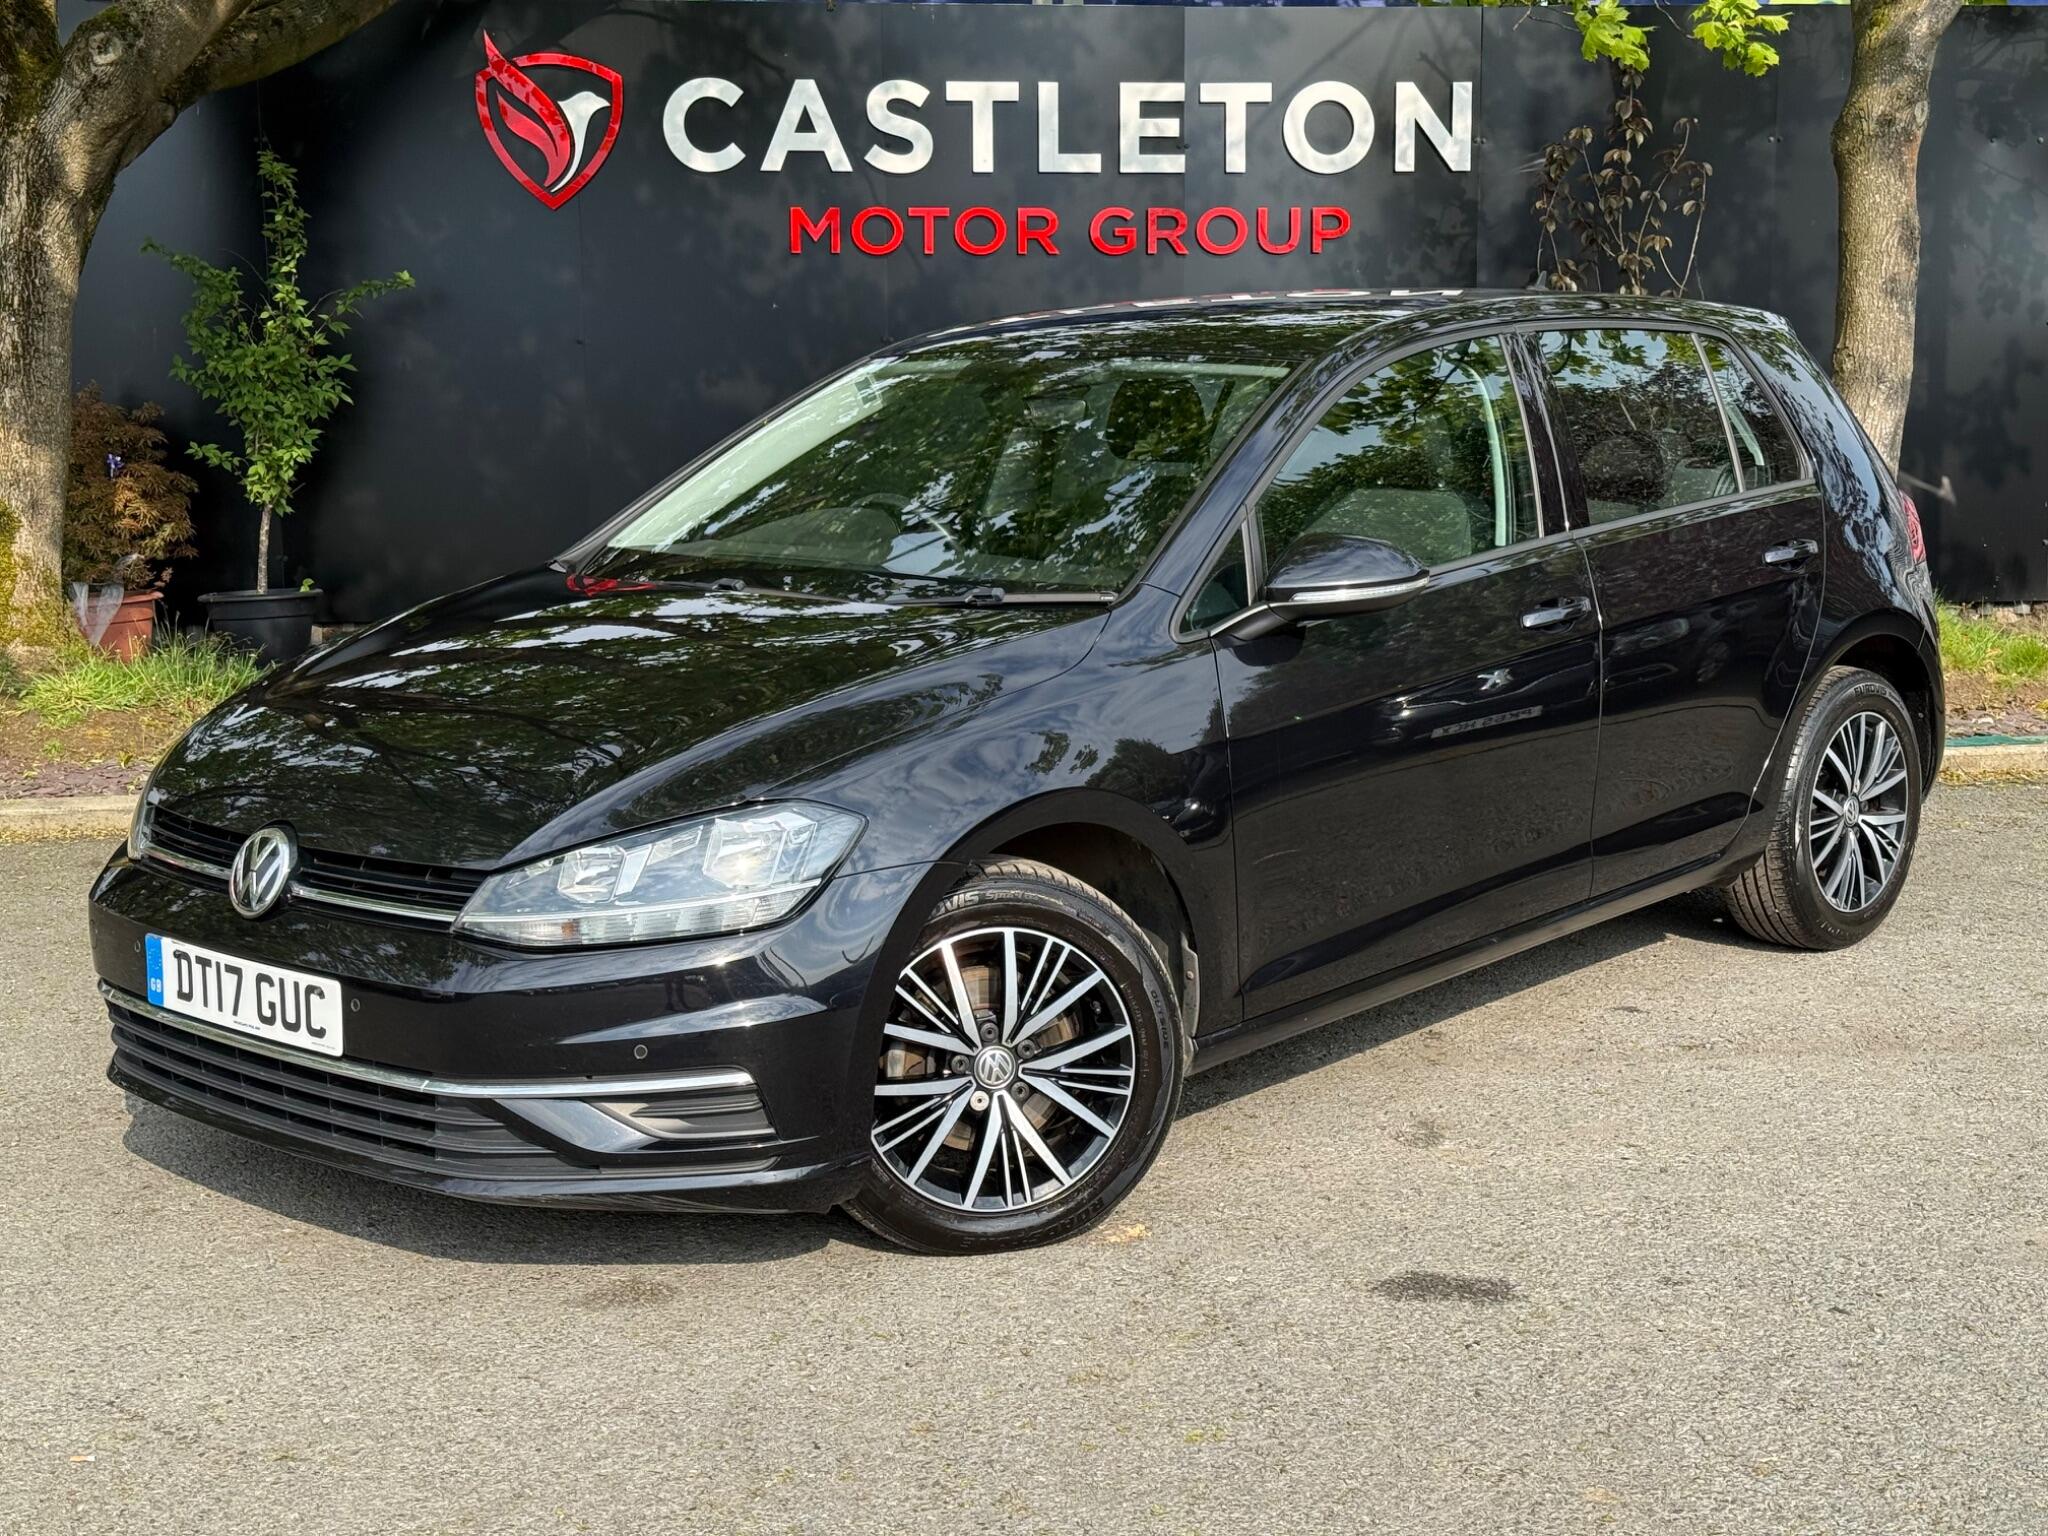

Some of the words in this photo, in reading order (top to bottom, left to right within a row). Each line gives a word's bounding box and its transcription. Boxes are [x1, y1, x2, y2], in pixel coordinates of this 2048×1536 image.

[662, 77, 1474, 175] CASTLETON
[788, 206, 1060, 256] MOTOR
[1089, 206, 1352, 256] GROUP
[173, 949, 244, 1017] DT17
[255, 972, 327, 1039] GUC
